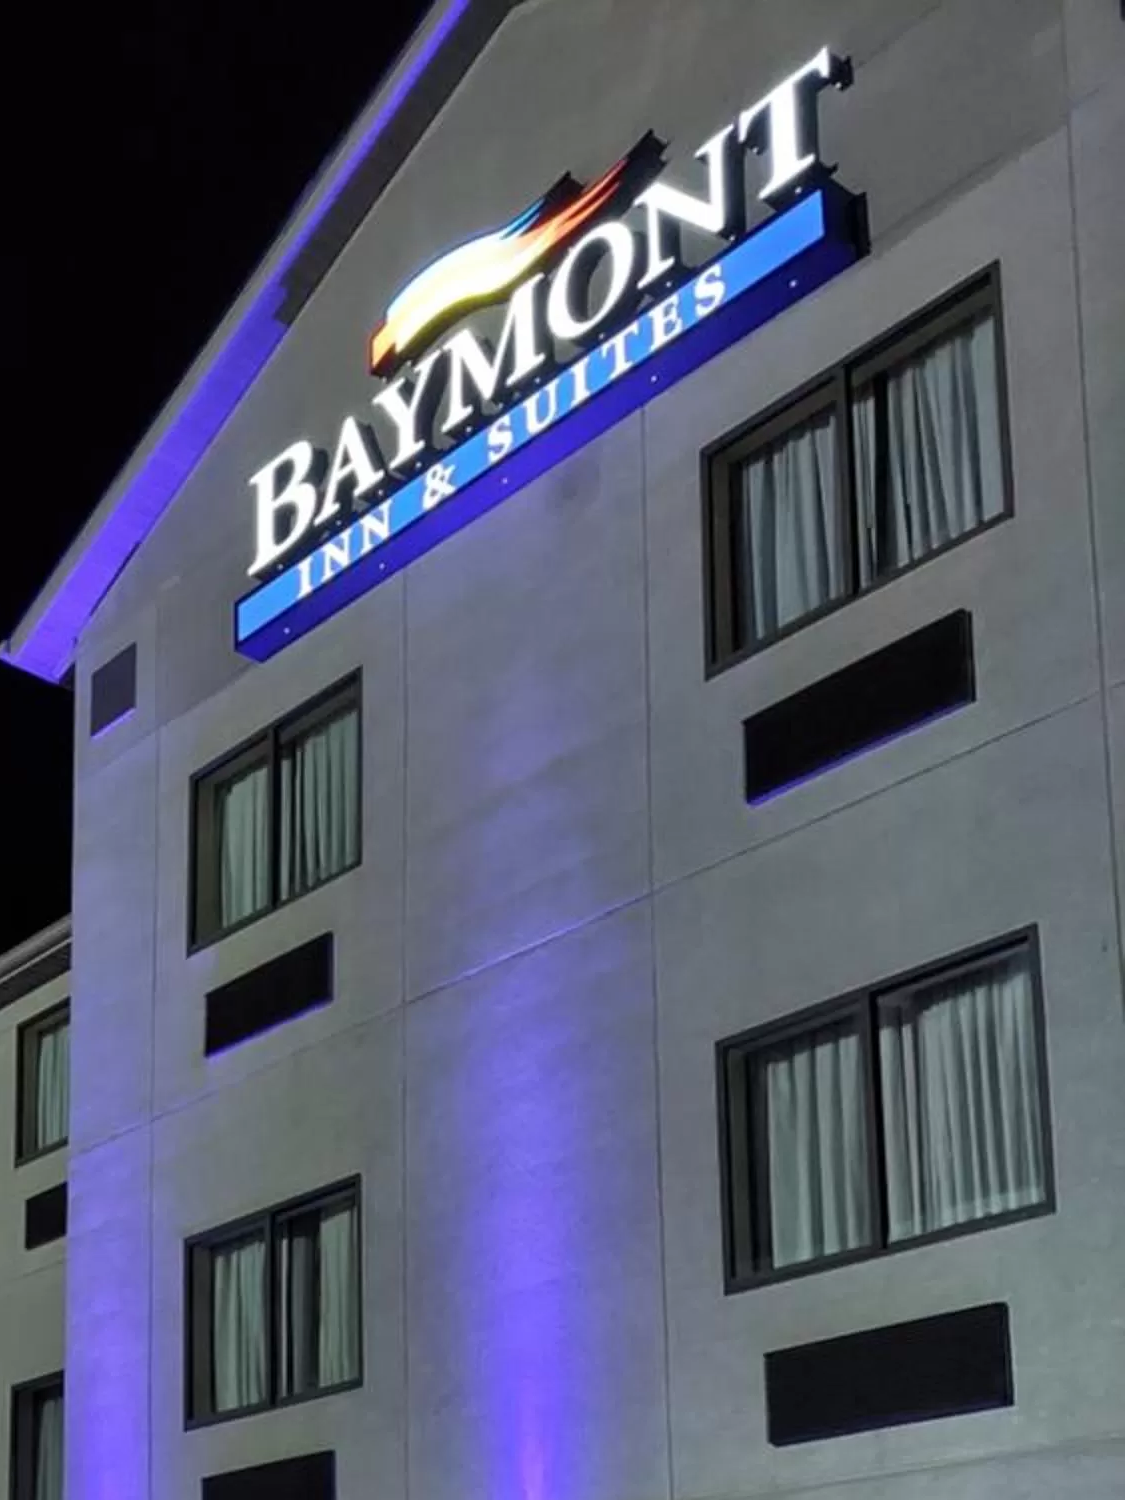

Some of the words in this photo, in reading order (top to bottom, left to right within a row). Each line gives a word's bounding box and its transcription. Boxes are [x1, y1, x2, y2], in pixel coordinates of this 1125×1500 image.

[247, 46, 832, 577] BAYMONT
[295, 499, 391, 600] INN
[422, 463, 457, 505] &
[486, 264, 726, 463] SUITES
